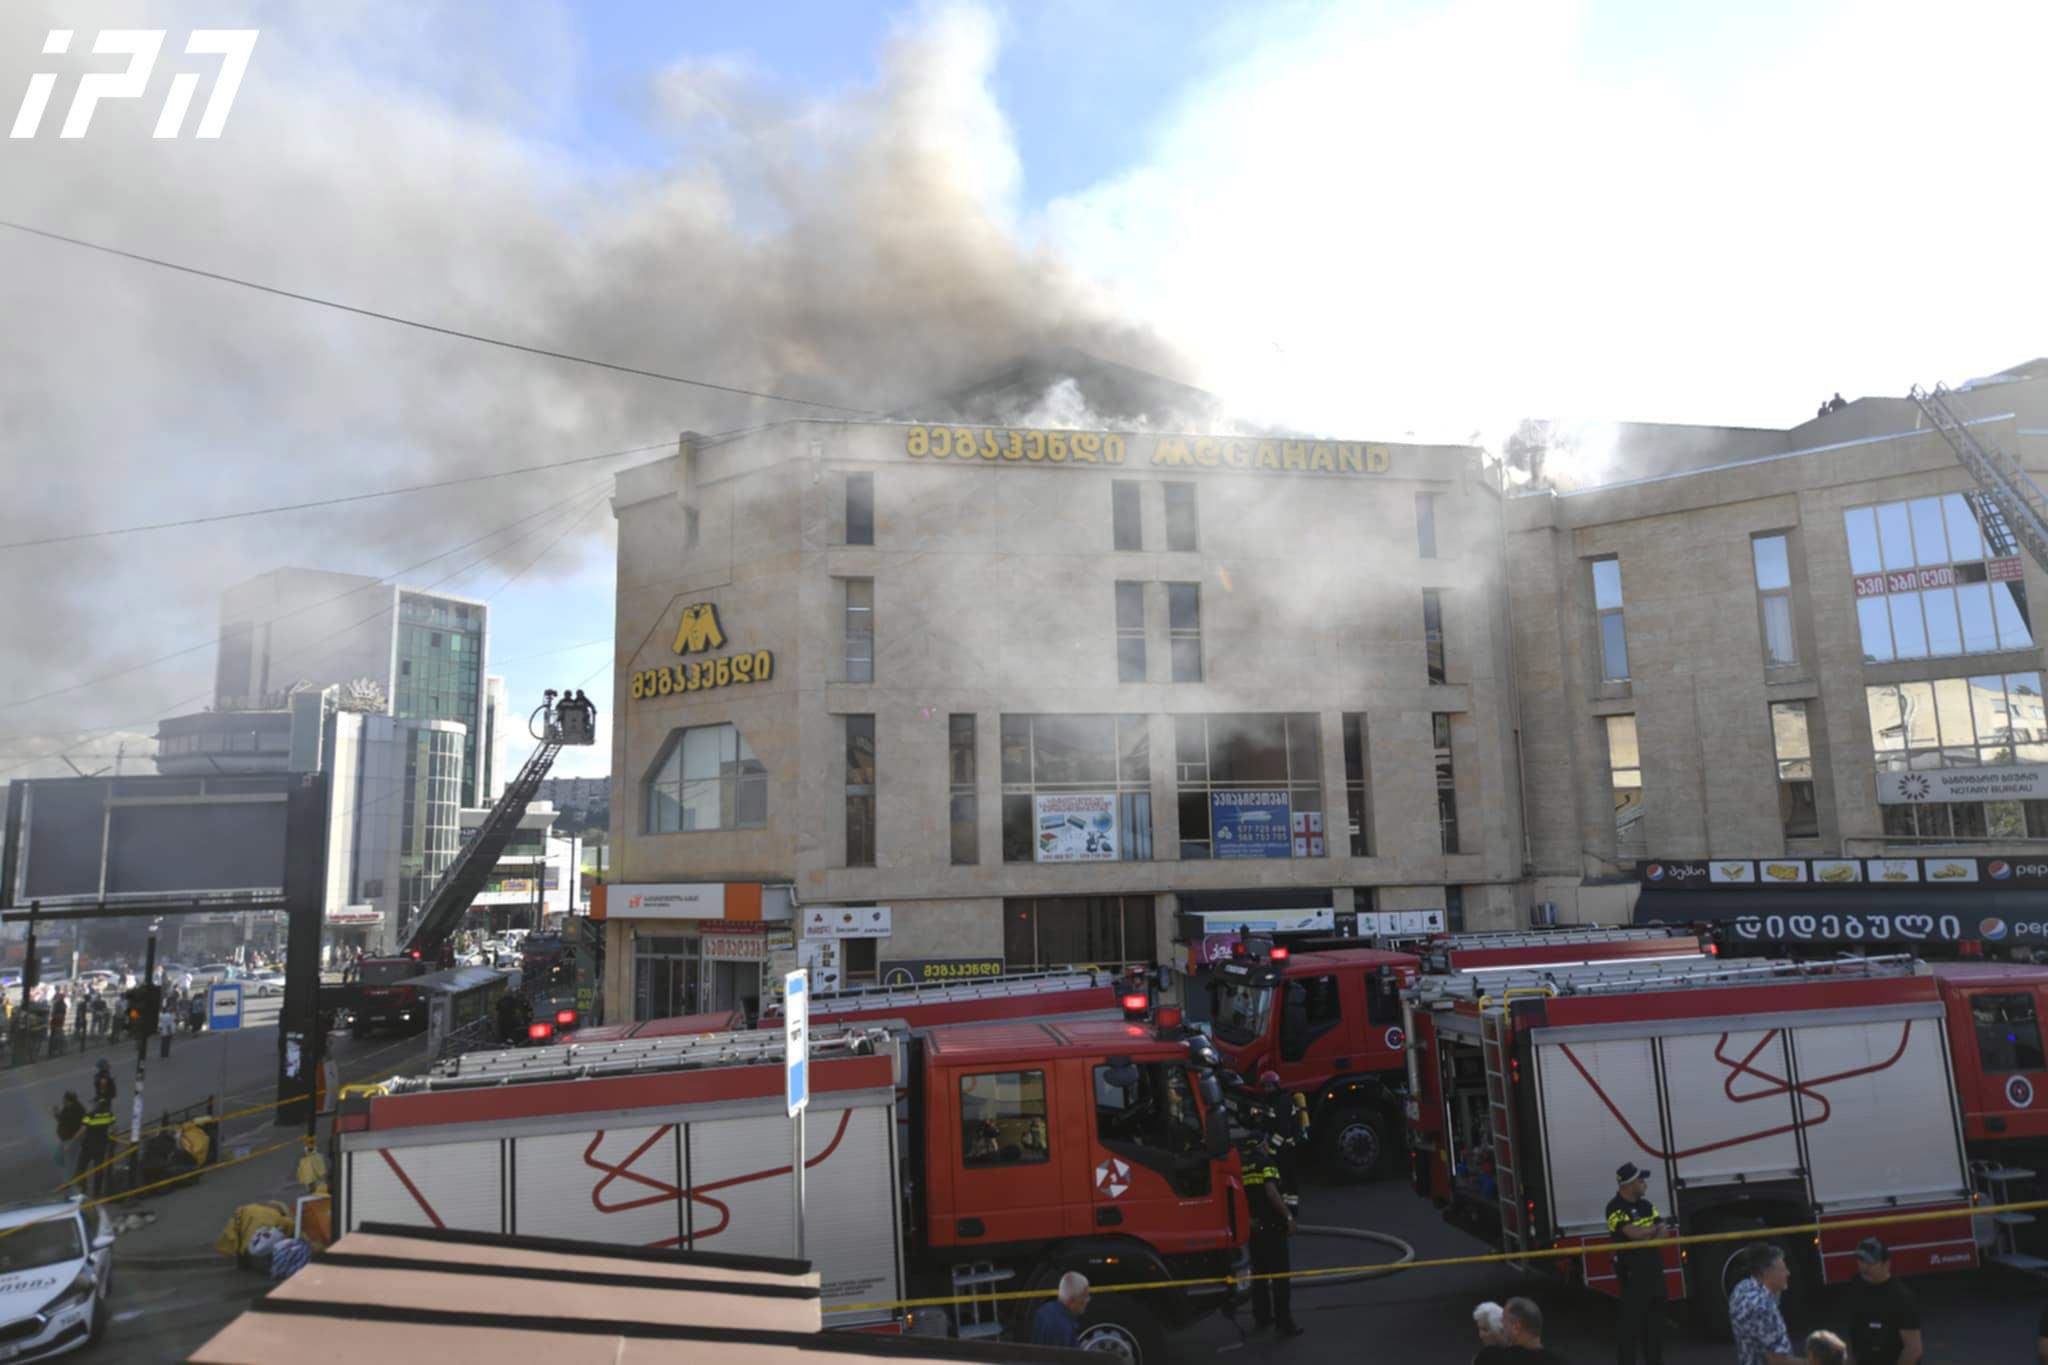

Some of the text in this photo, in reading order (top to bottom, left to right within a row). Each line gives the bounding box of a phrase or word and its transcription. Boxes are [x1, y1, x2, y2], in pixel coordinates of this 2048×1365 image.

[907, 426, 1125, 464] მეგაჰენდი
[631, 650, 772, 699] მეგაჰენდი
[1736, 915, 1960, 939] დიდებული
